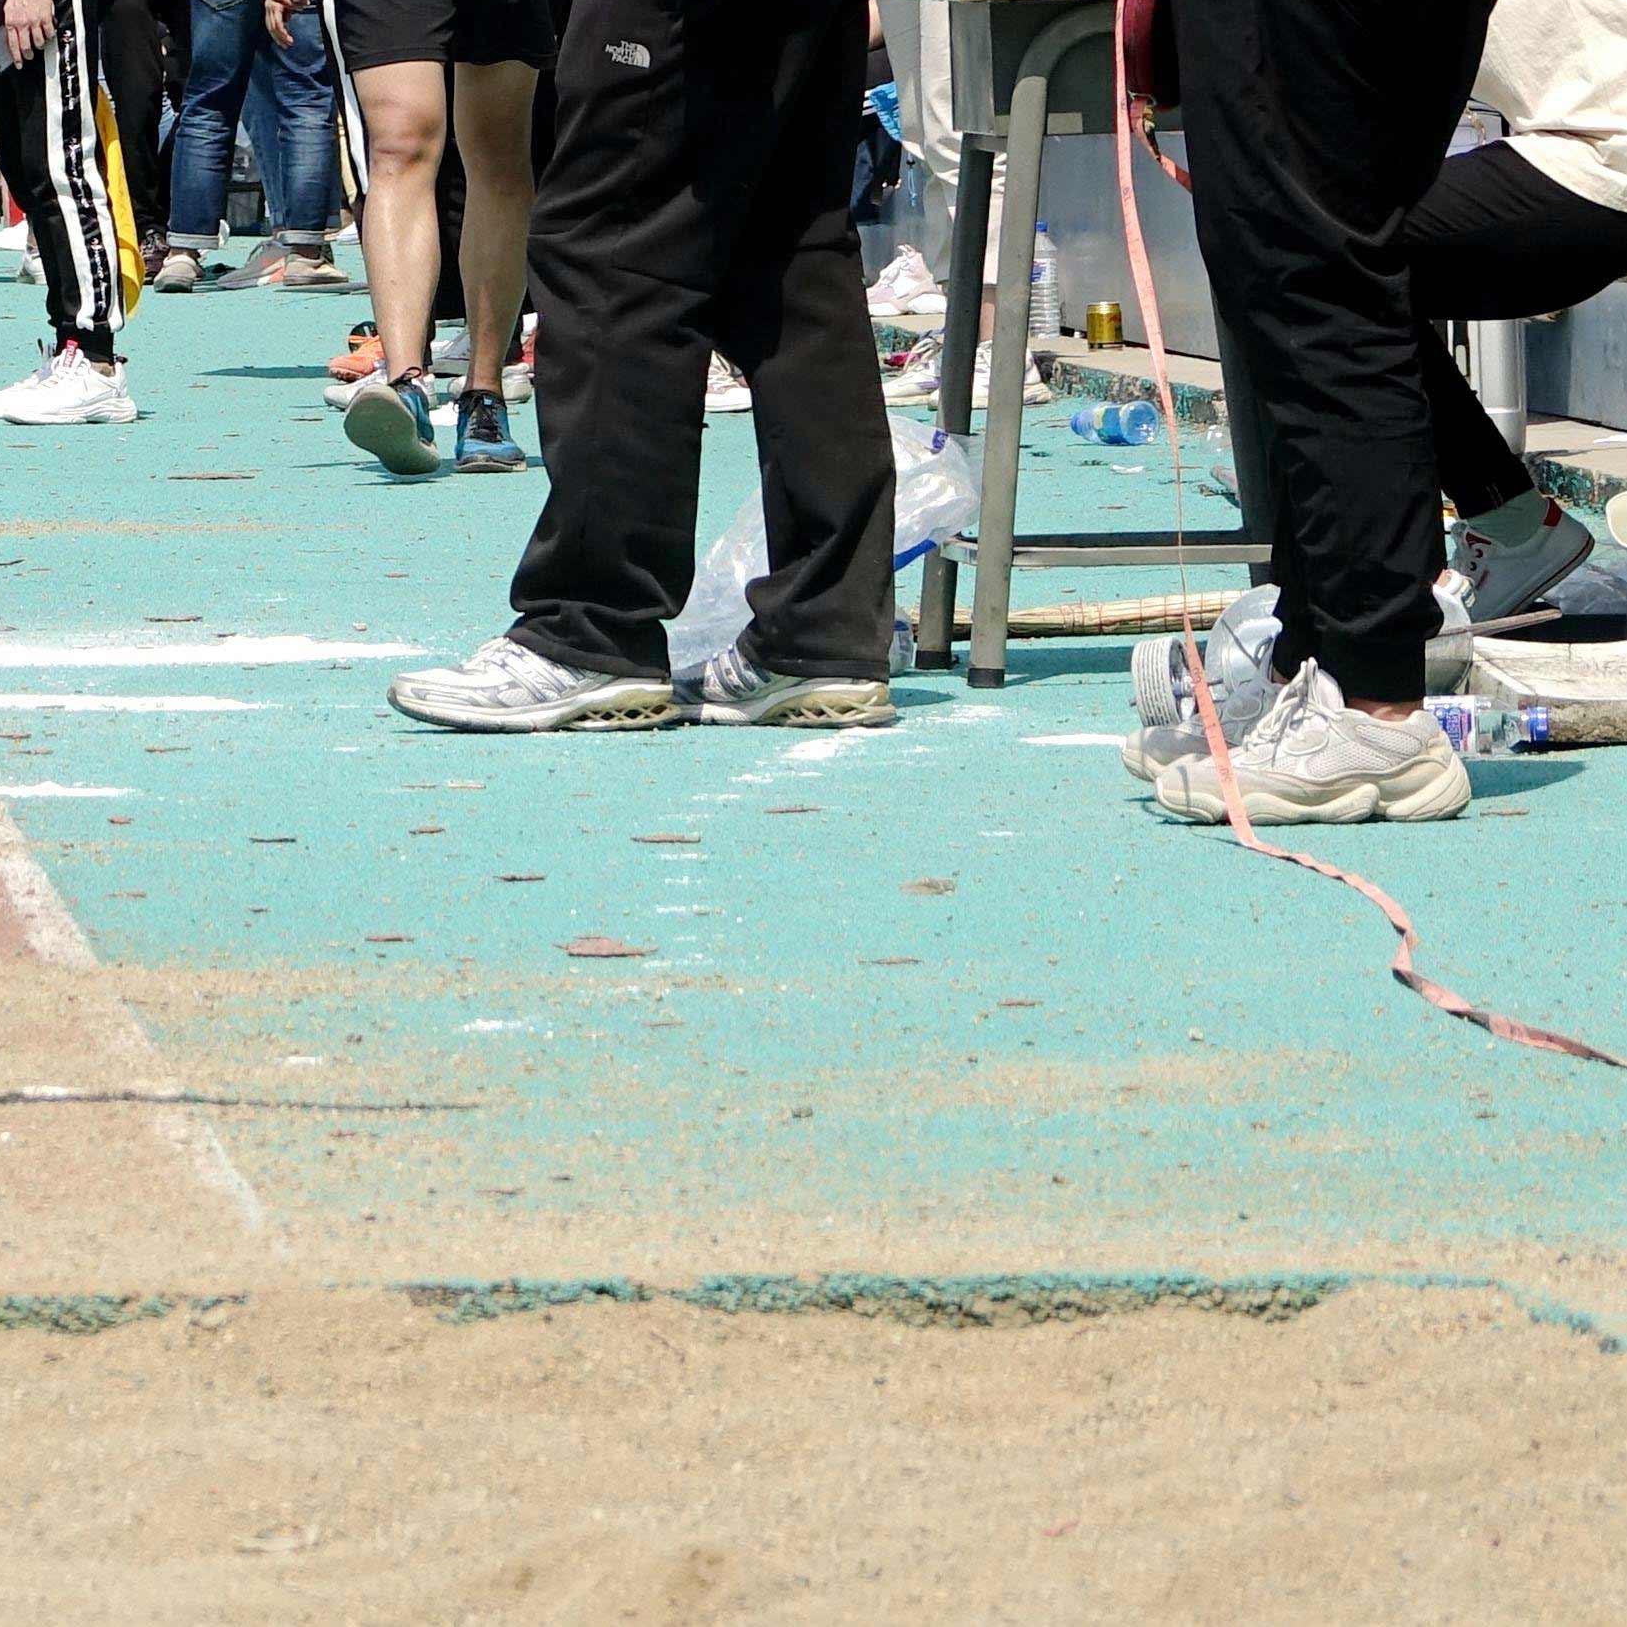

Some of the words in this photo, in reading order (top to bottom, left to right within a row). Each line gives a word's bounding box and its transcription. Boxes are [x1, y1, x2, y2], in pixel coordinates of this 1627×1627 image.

[605, 44, 635, 57] NORTH
[621, 40, 636, 51] THE
[611, 53, 635, 65] FACE
